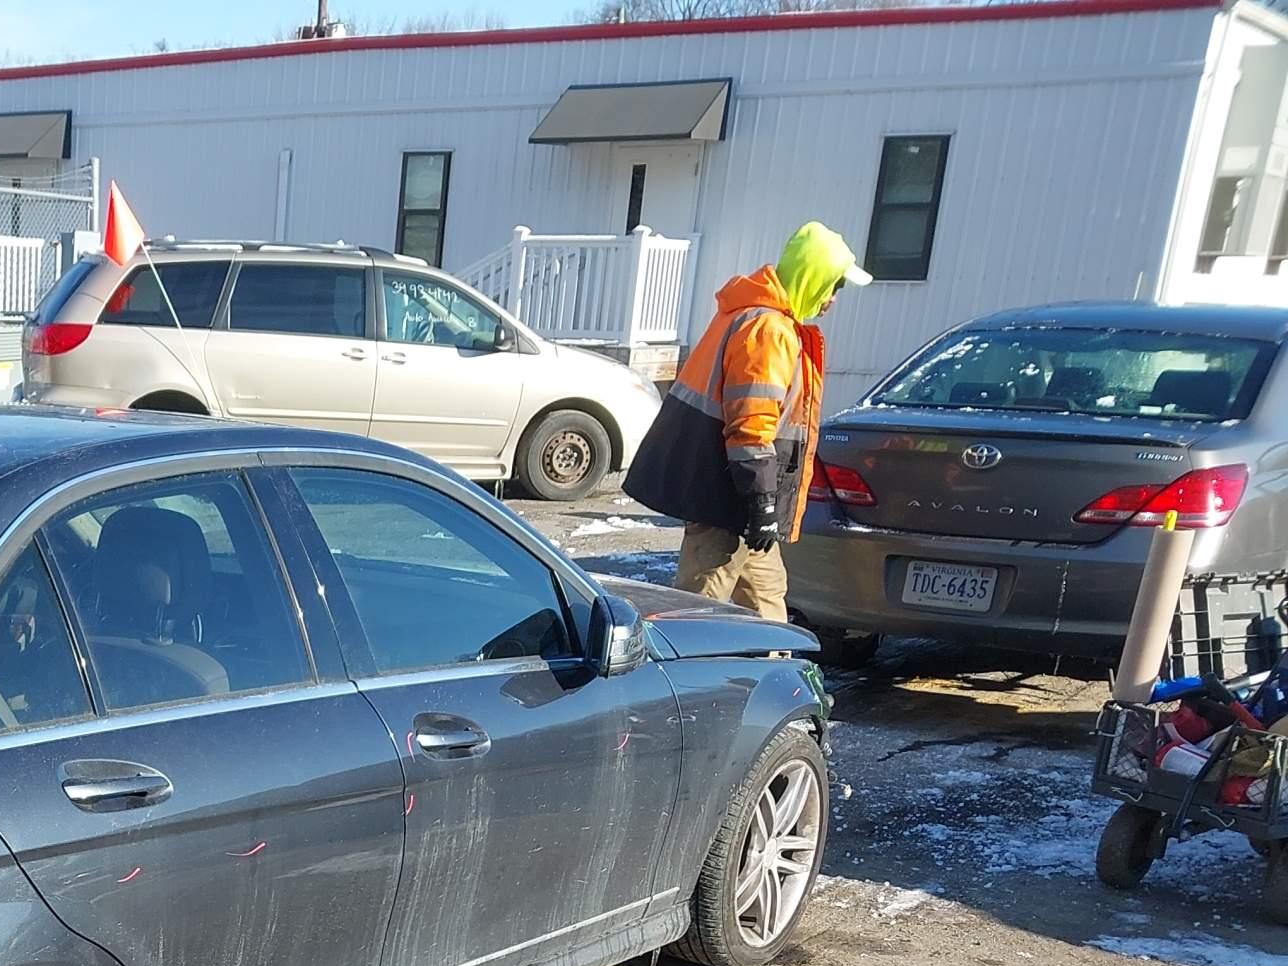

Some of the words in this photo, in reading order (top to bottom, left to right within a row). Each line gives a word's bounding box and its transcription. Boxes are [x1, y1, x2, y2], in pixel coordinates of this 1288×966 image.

[907, 499, 1038, 517] AVALON
[932, 566, 973, 577] VIRGINIA
[912, 572, 989, 600] TDC-6435
